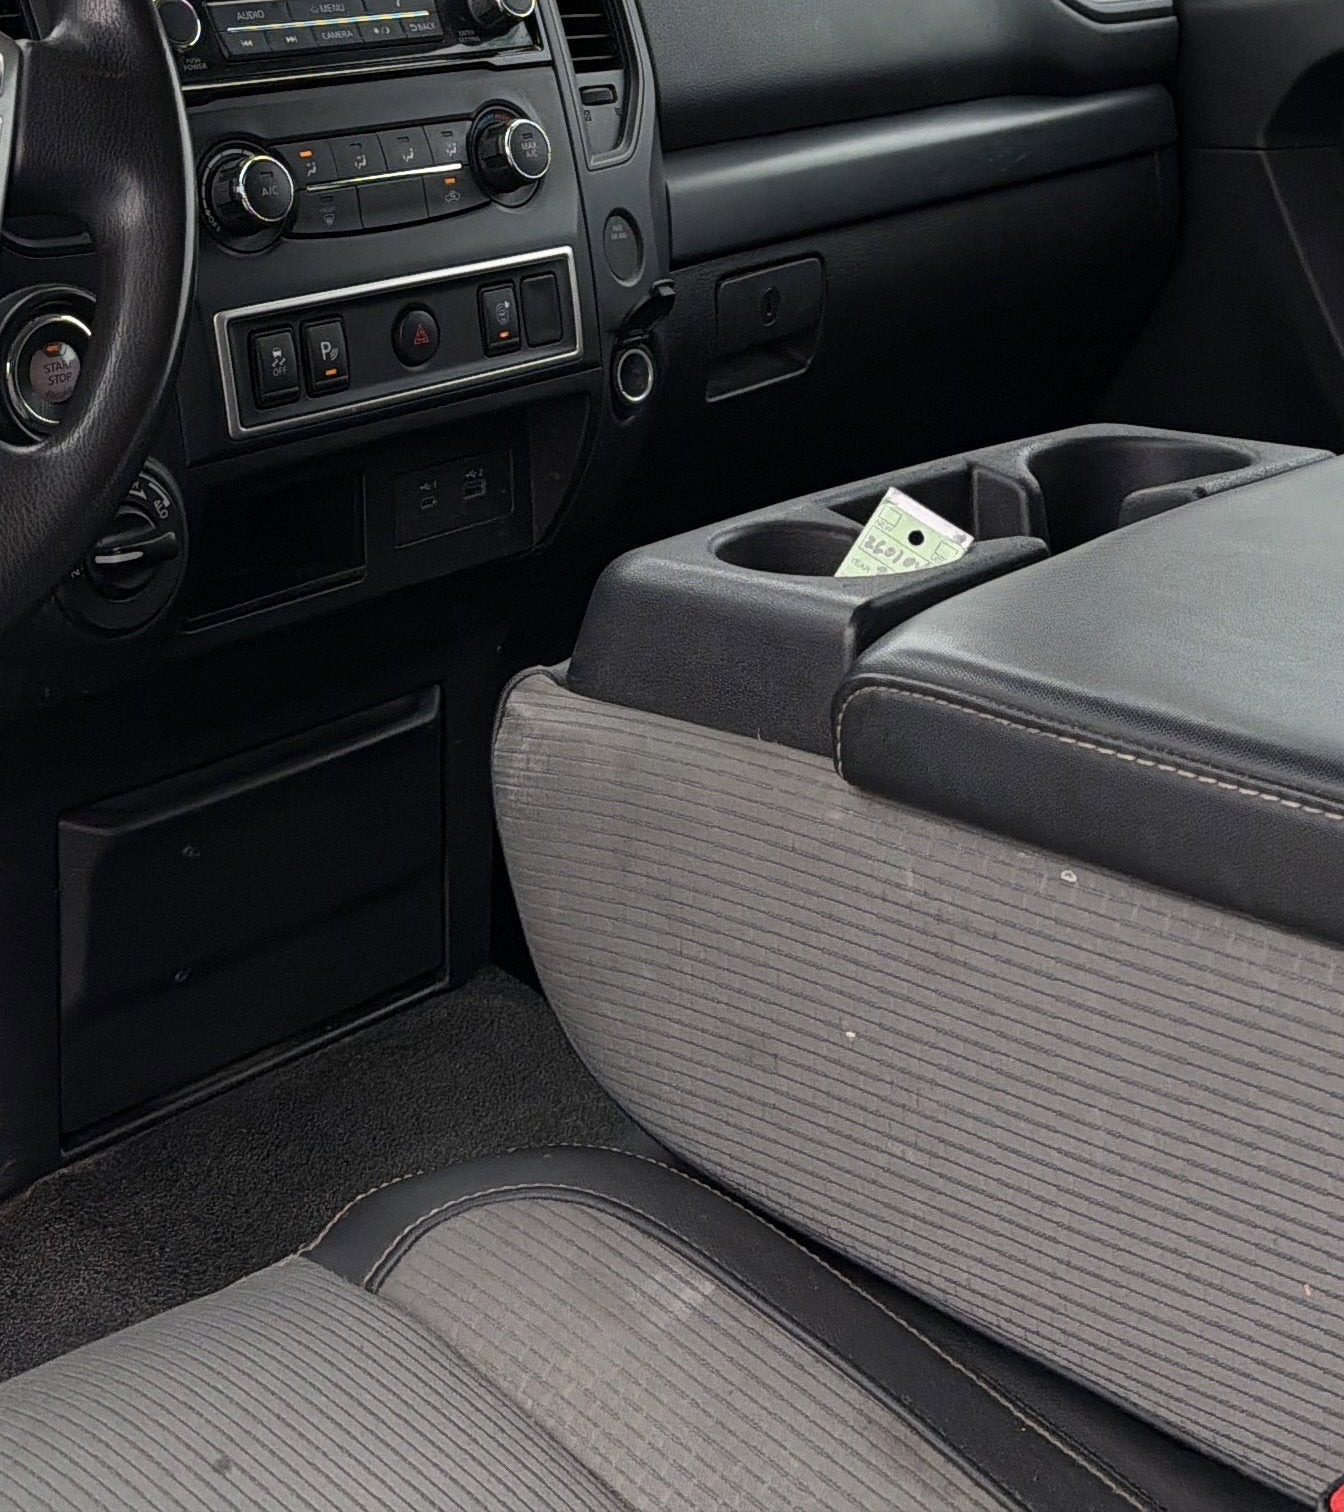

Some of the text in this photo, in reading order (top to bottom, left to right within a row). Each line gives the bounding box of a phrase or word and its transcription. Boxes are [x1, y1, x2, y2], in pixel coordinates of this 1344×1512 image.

[319, 2, 346, 14] MENU
[236, 9, 265, 22] AUDIO
[416, 22, 437, 33] BACK
[321, 28, 354, 41] CAMERA
[262, 185, 278, 196] A/C
[272, 366, 288, 376] OFF
[48, 372, 72, 385] STOP
[850, 557, 871, 572] YEAR
